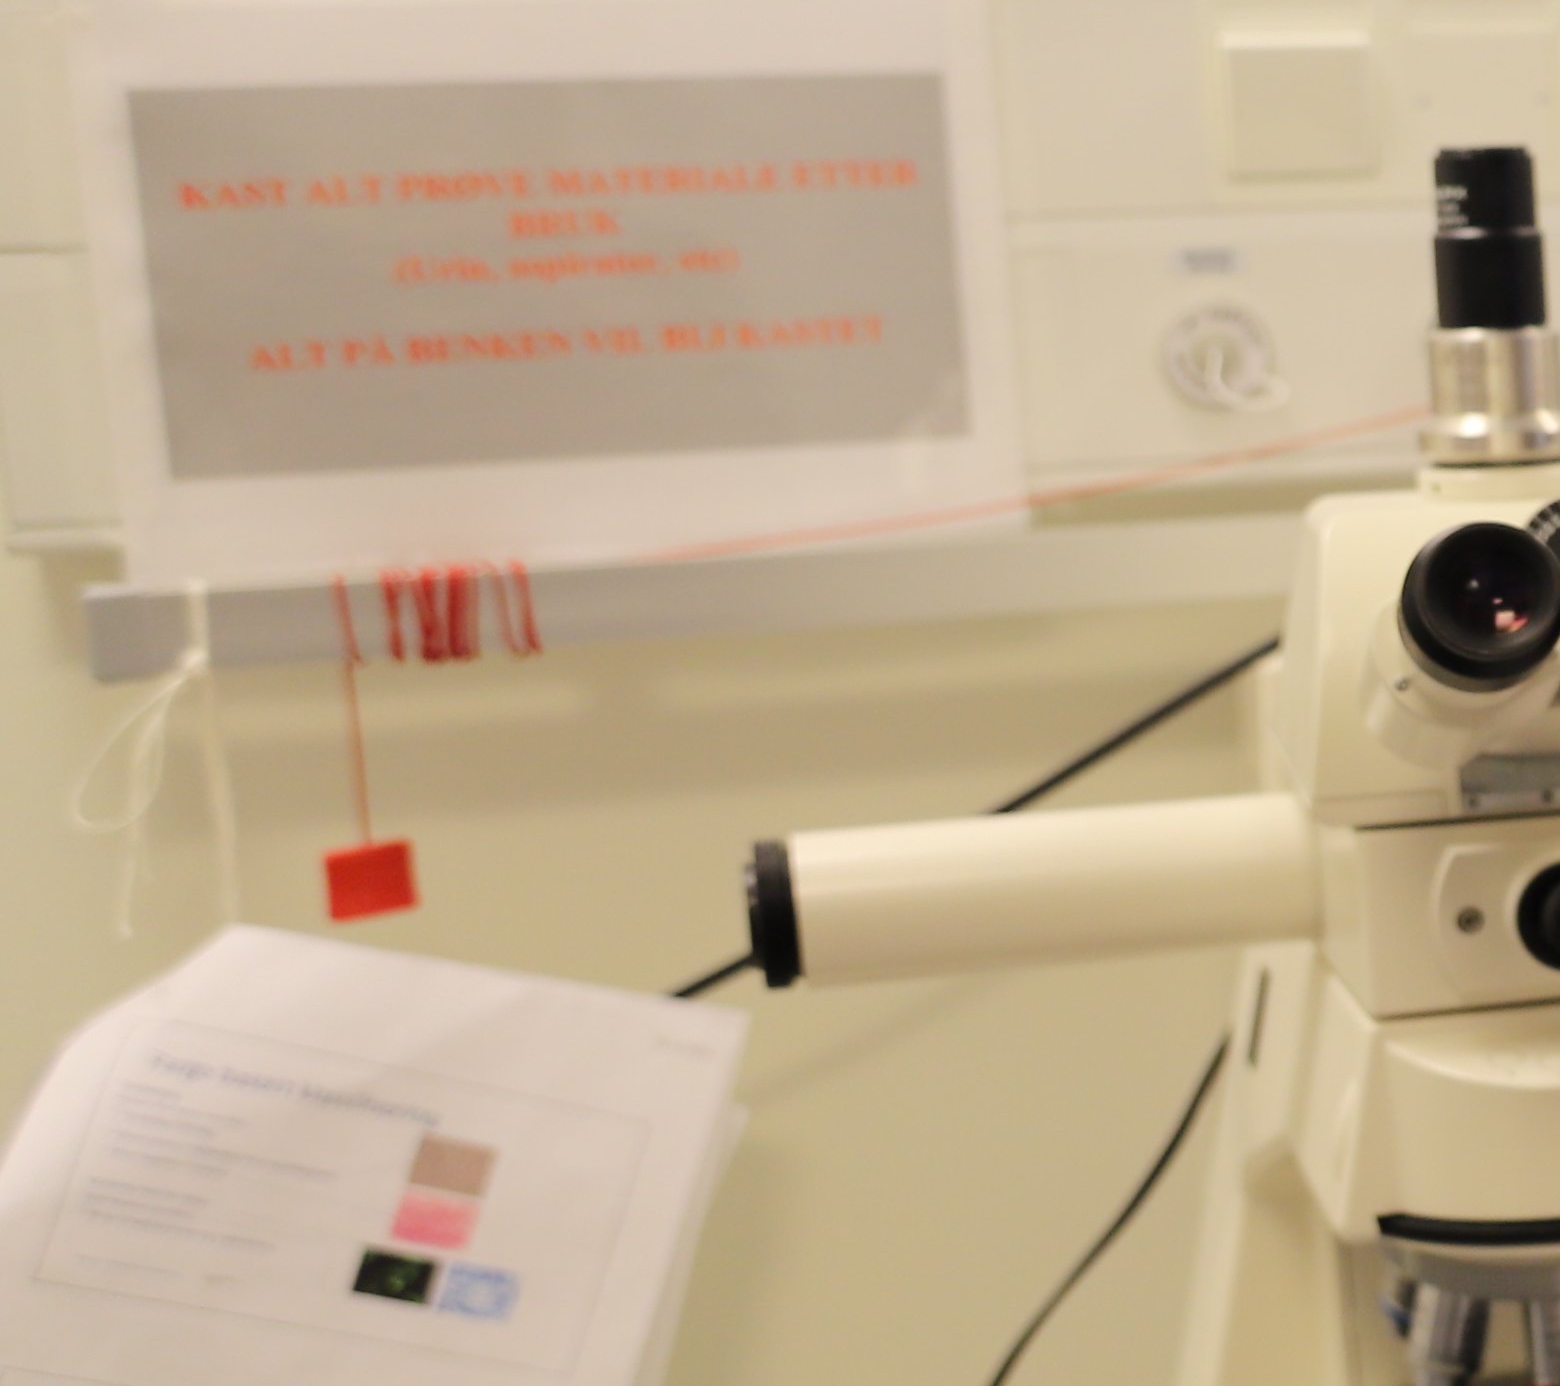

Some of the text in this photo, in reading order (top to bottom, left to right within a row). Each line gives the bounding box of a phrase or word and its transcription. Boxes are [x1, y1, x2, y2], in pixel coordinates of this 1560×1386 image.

[179, 178, 287, 210] KAST
[307, 174, 383, 207] ALT
[546, 160, 778, 197] MATERIALE
[790, 156, 918, 192] ETTER
[252, 334, 328, 371] ALT
[342, 330, 396, 368] PÅ
